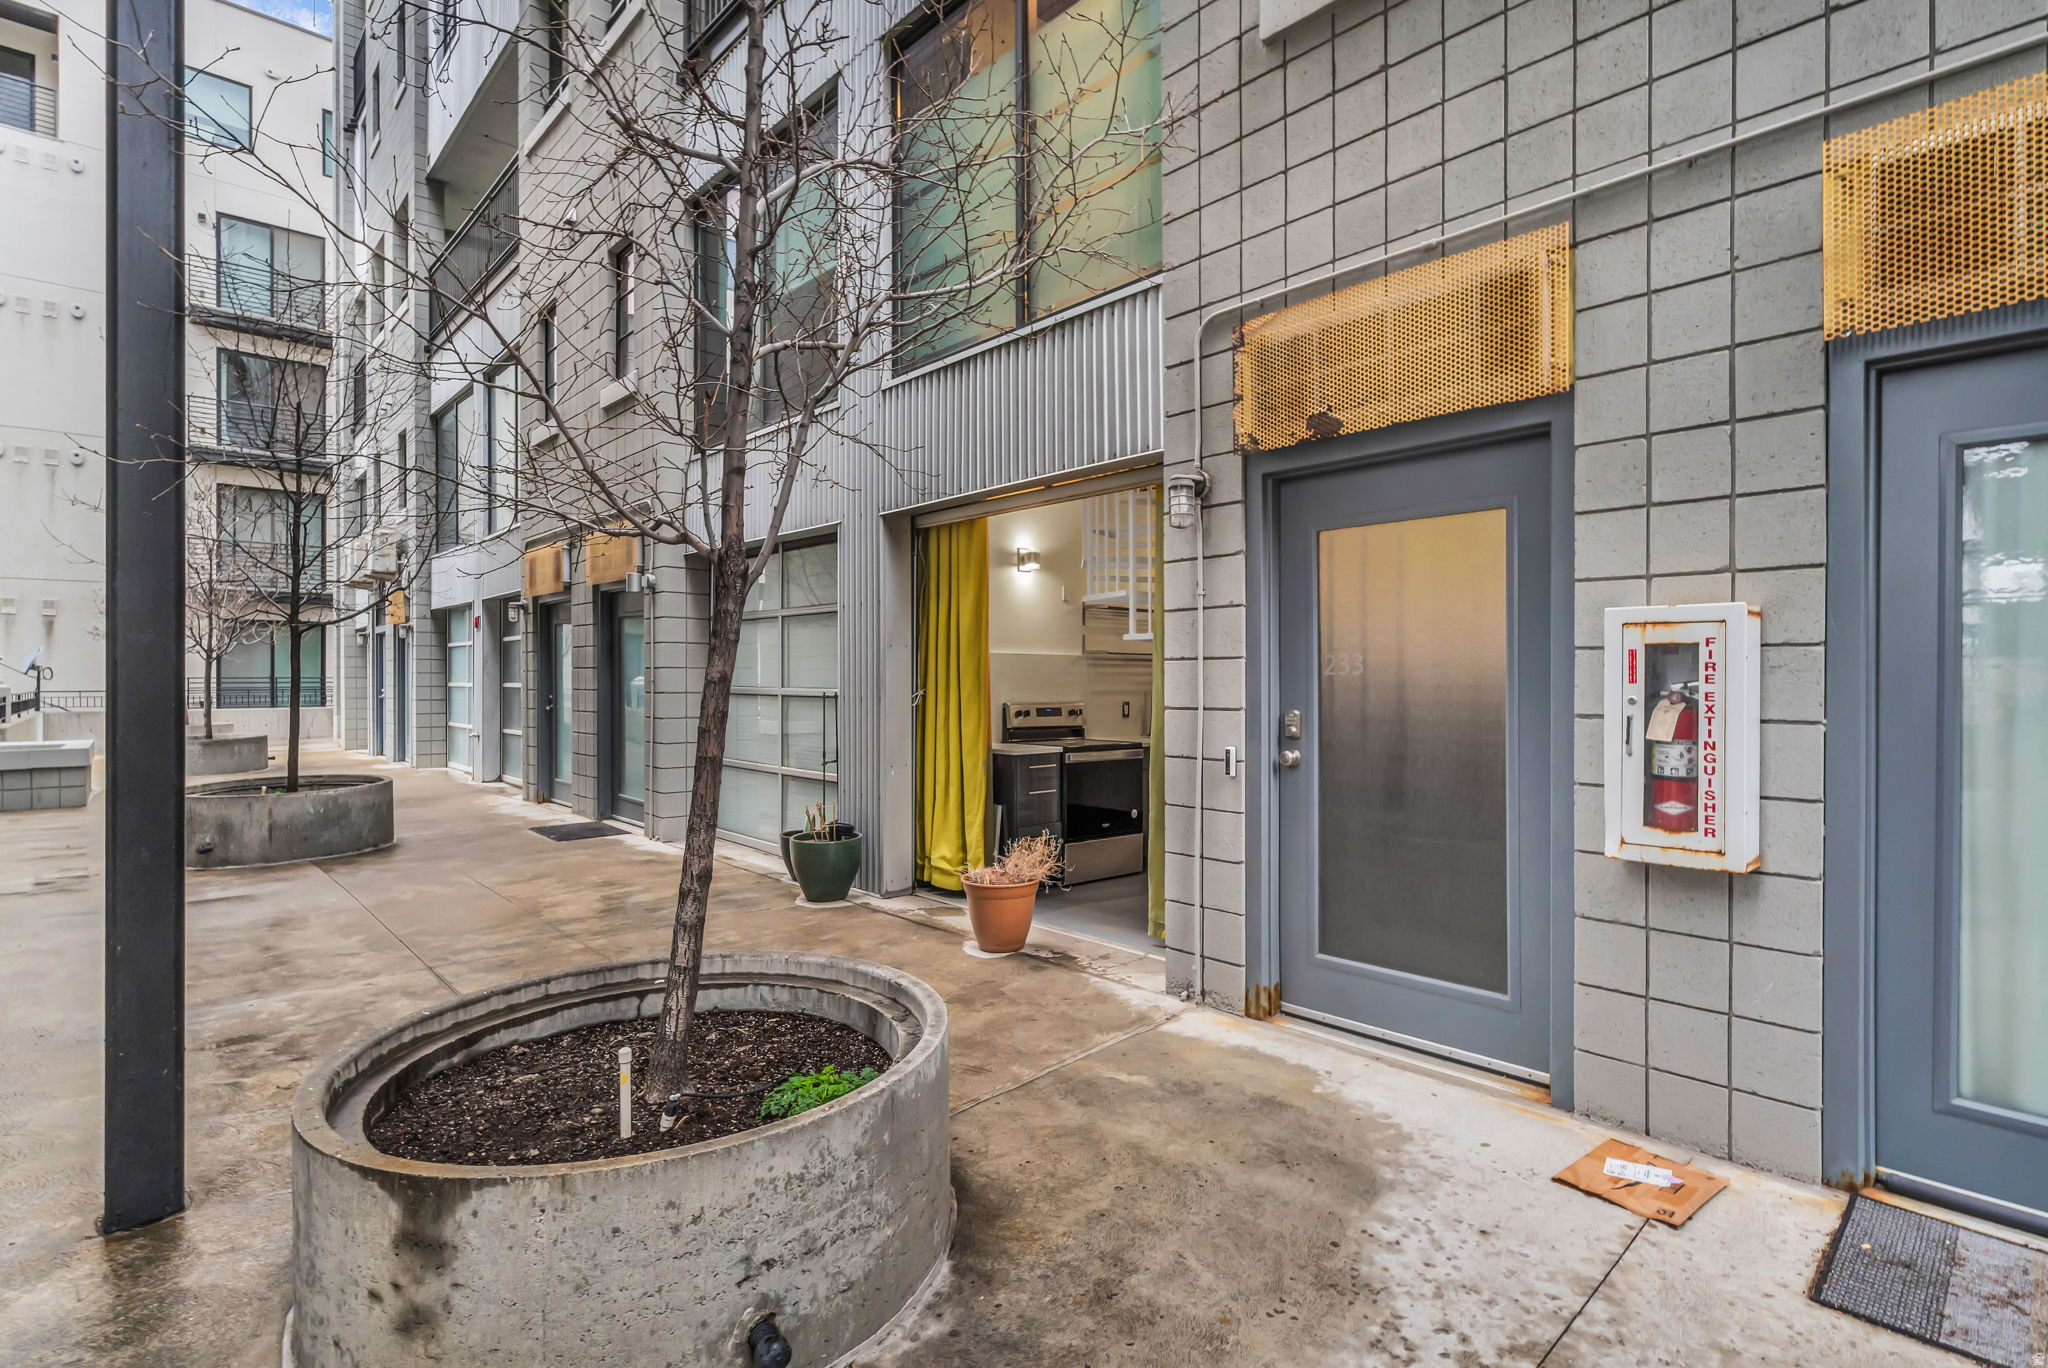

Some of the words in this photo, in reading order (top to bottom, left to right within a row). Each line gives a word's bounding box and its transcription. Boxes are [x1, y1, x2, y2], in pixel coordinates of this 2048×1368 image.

[1323, 653, 1364, 676] 233
[1705, 637, 1716, 685] FIRE
[1704, 692, 1716, 838] EXTINGUISHER
